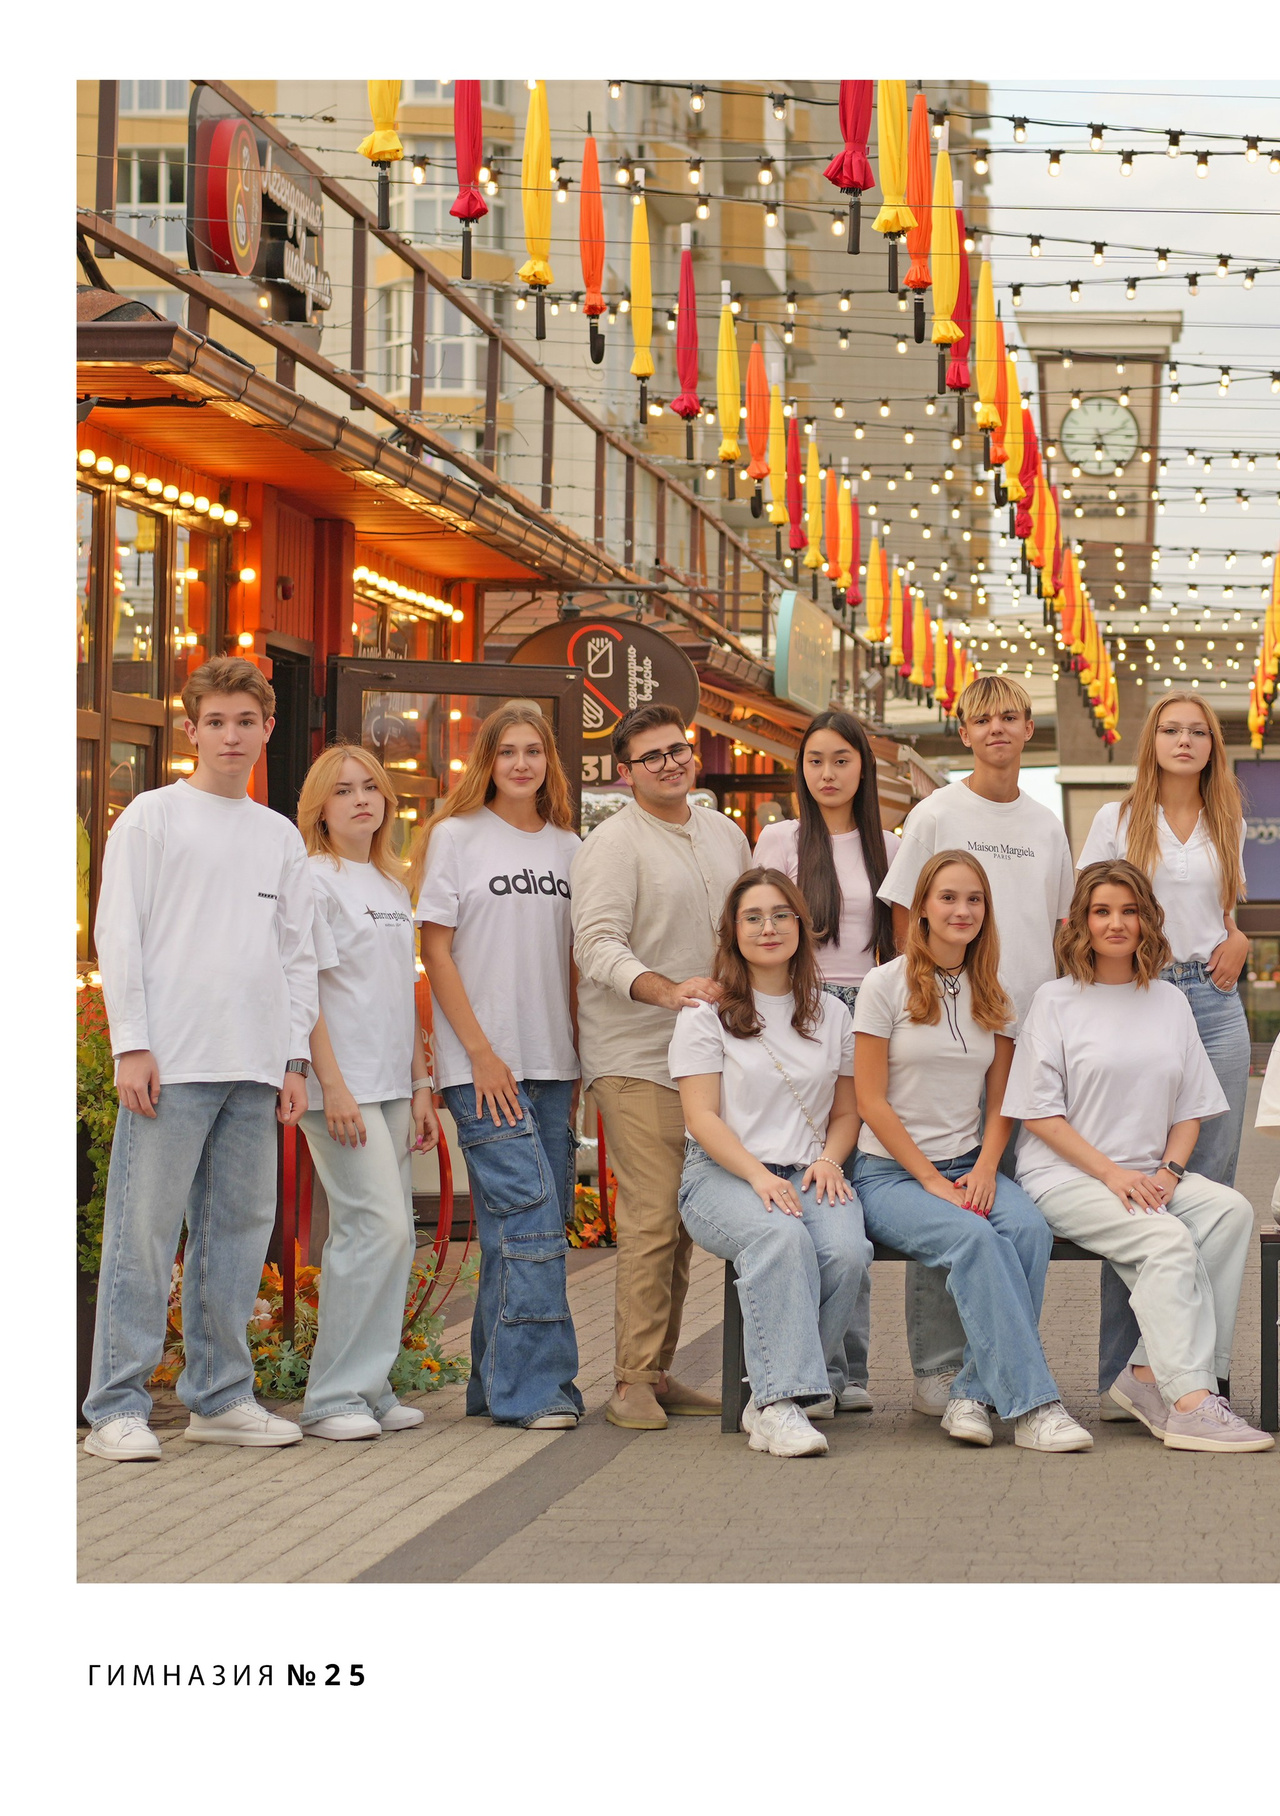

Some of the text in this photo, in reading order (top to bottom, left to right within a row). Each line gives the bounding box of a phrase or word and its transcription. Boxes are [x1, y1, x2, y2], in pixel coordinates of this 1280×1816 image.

[627, 644, 644, 710] егендарно
[582, 754, 612, 782] 31
[967, 841, 1035, 858] Maison Margiela
[488, 868, 572, 900] adida
